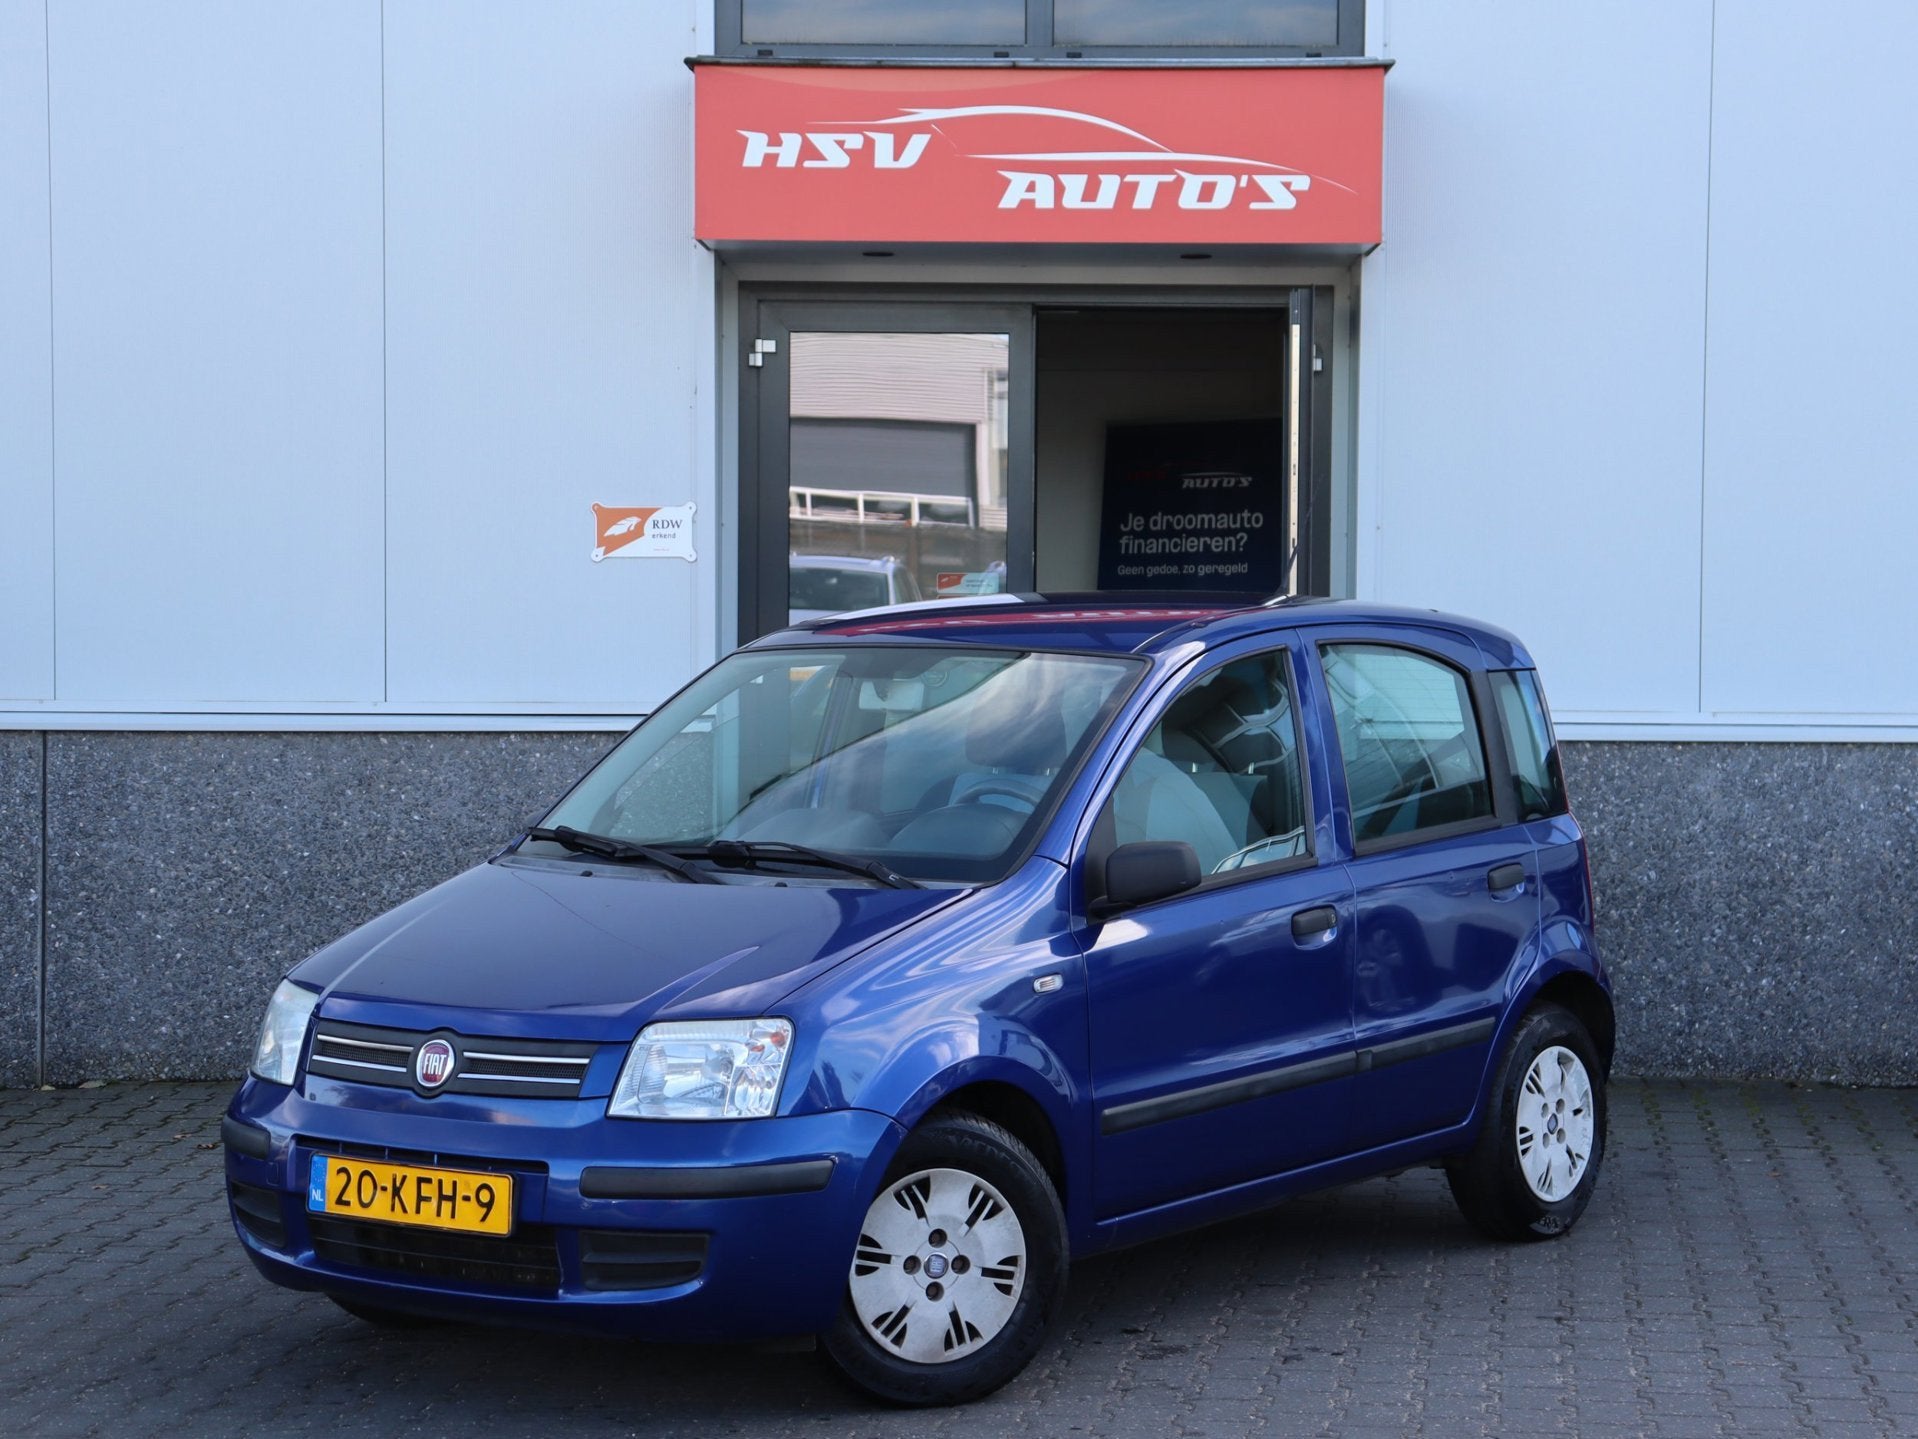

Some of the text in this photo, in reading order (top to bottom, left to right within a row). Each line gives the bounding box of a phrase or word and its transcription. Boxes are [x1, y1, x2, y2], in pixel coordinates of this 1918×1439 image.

[736, 129, 932, 168] HSV
[996, 168, 1310, 210] AUTO'S
[1182, 476, 1252, 489] AUTO'S
[652, 519, 683, 529] RDW
[1119, 509, 1264, 532] Je droomauto
[1119, 532, 1248, 555] financieren?
[1117, 562, 1249, 577] Geen gedoe, zo geregeld
[424, 1053, 447, 1076] FIAT
[311, 1189, 324, 1202] NL
[335, 1166, 496, 1223] 20-KFH-9
